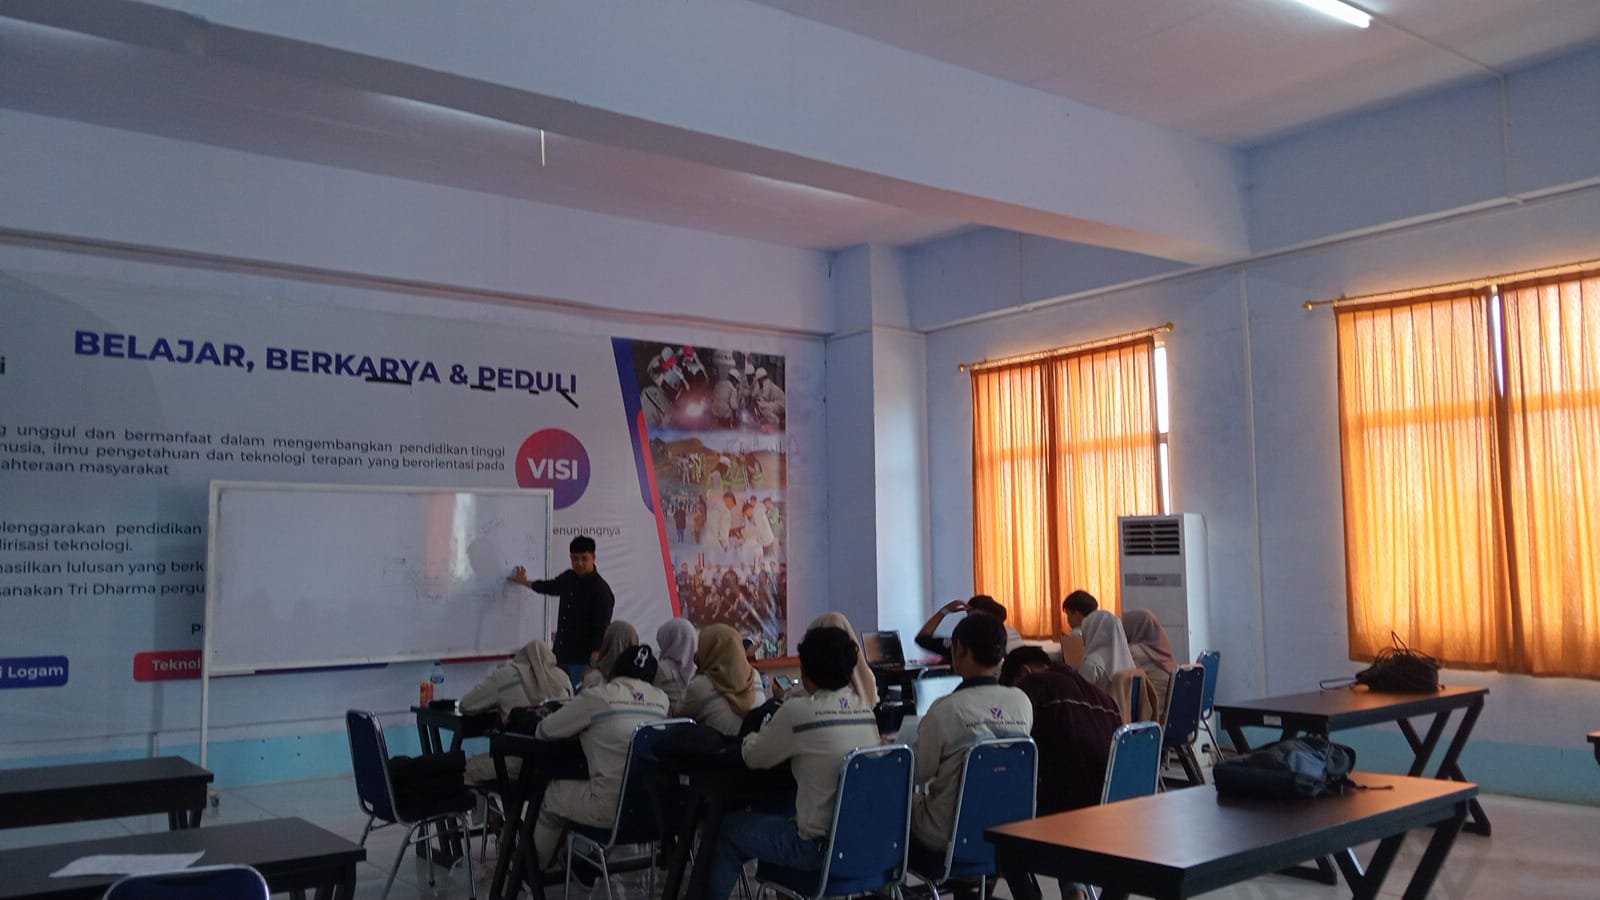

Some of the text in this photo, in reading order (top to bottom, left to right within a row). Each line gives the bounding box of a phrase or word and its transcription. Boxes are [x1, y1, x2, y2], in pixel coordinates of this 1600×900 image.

[75, 330, 577, 394] BELAJAR, BERKARYA & PEDULI
[17, 426, 75, 440] unggul
[85, 427, 115, 440] dan
[125, 429, 212, 444] bermanfaat
[220, 433, 265, 447] dalam
[273, 438, 392, 453] mengembangkan
[400, 442, 468, 456] pendidikan
[471, 445, 505, 459] tinggi
[53, 442, 89, 456] ilmu
[96, 446, 200, 460] pengetahuan
[206, 449, 234, 461] dan
[241, 451, 306, 466] teknologi
[312, 454, 363, 467] terapan
[368, 458, 400, 469] yang
[402, 457, 474, 471] berorientasi
[476, 460, 505, 472] pada
[1, 458, 169, 476] ahteraan masyarakat
[527, 458, 578, 481] VISI
[116, 522, 202, 536] pendidikan
[54, 539, 133, 554] teknologi.
[67, 561, 124, 574] lulusan
[128, 563, 166, 576] yang
[171, 560, 205, 573] berk
[67, 583, 87, 596] Tri
[93, 583, 156, 596] Dharma
[161, 584, 205, 597] pergu
[8, 665, 64, 680] Logam
